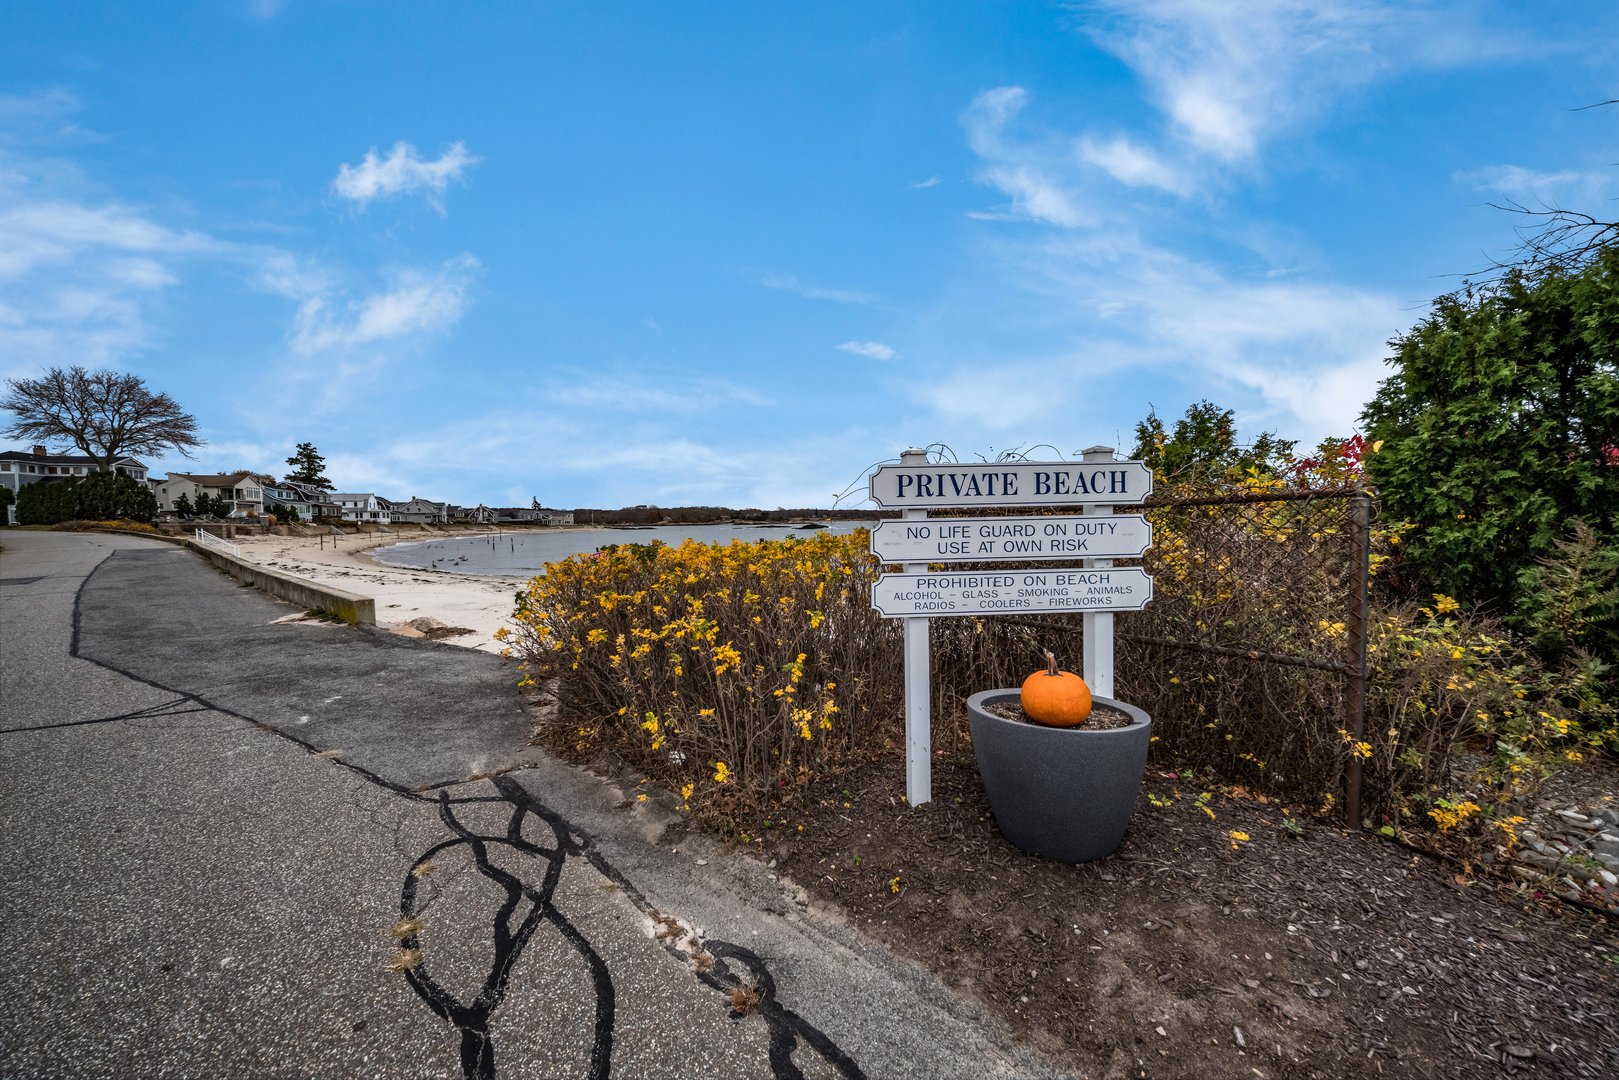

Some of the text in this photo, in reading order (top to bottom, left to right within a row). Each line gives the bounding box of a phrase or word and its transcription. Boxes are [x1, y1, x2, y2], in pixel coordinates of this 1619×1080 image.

[896, 470, 1128, 498] PRIVATE BEACH
[907, 523, 1118, 539] NO LIFE GUARD ON DUTY
[938, 539, 1088, 554] USE AT OWN RISK
[917, 574, 1110, 589] PROHIBITED ON BEACH
[894, 591, 944, 600] ALCOHOL
[962, 590, 998, 598] GLASS
[1018, 588, 1069, 597] SMOKING
[1086, 586, 1132, 595] ANIMALS
[915, 601, 955, 610] RADIOS
[980, 599, 1030, 608] COOLERS
[1049, 597, 1112, 606] FIREWORKS
